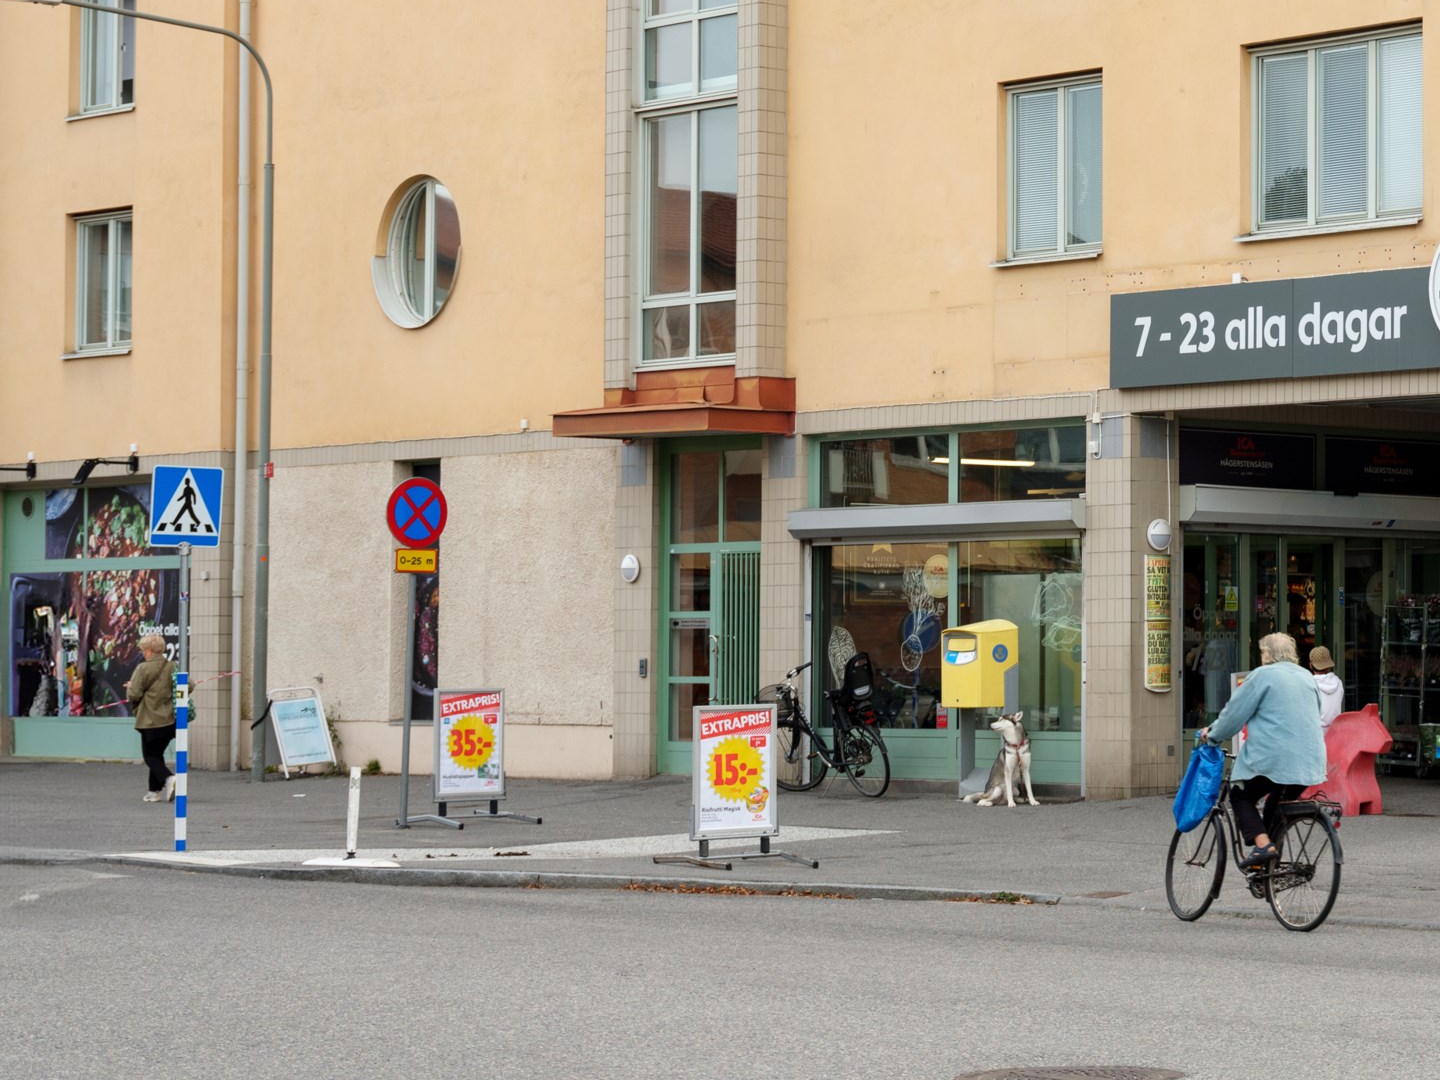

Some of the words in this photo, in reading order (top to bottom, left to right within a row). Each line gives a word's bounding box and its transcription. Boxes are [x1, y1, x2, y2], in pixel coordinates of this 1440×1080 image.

[1134, 316, 1152, 357] 7
[1179, 311, 1216, 354] 23
[1225, 306, 1286, 350] alla
[1298, 301, 1408, 353] dagar
[1237, 436, 1256, 451] ICA
[1380, 444, 1397, 457] ICA
[400, 556, 422, 565] 0-25
[138, 621, 164, 636] Öppet
[442, 693, 500, 714] EXTRAPRIS!
[701, 711, 770, 736] EXTRAPRIS!
[450, 728, 493, 757] 35:-
[713, 753, 758, 787] 15:-
